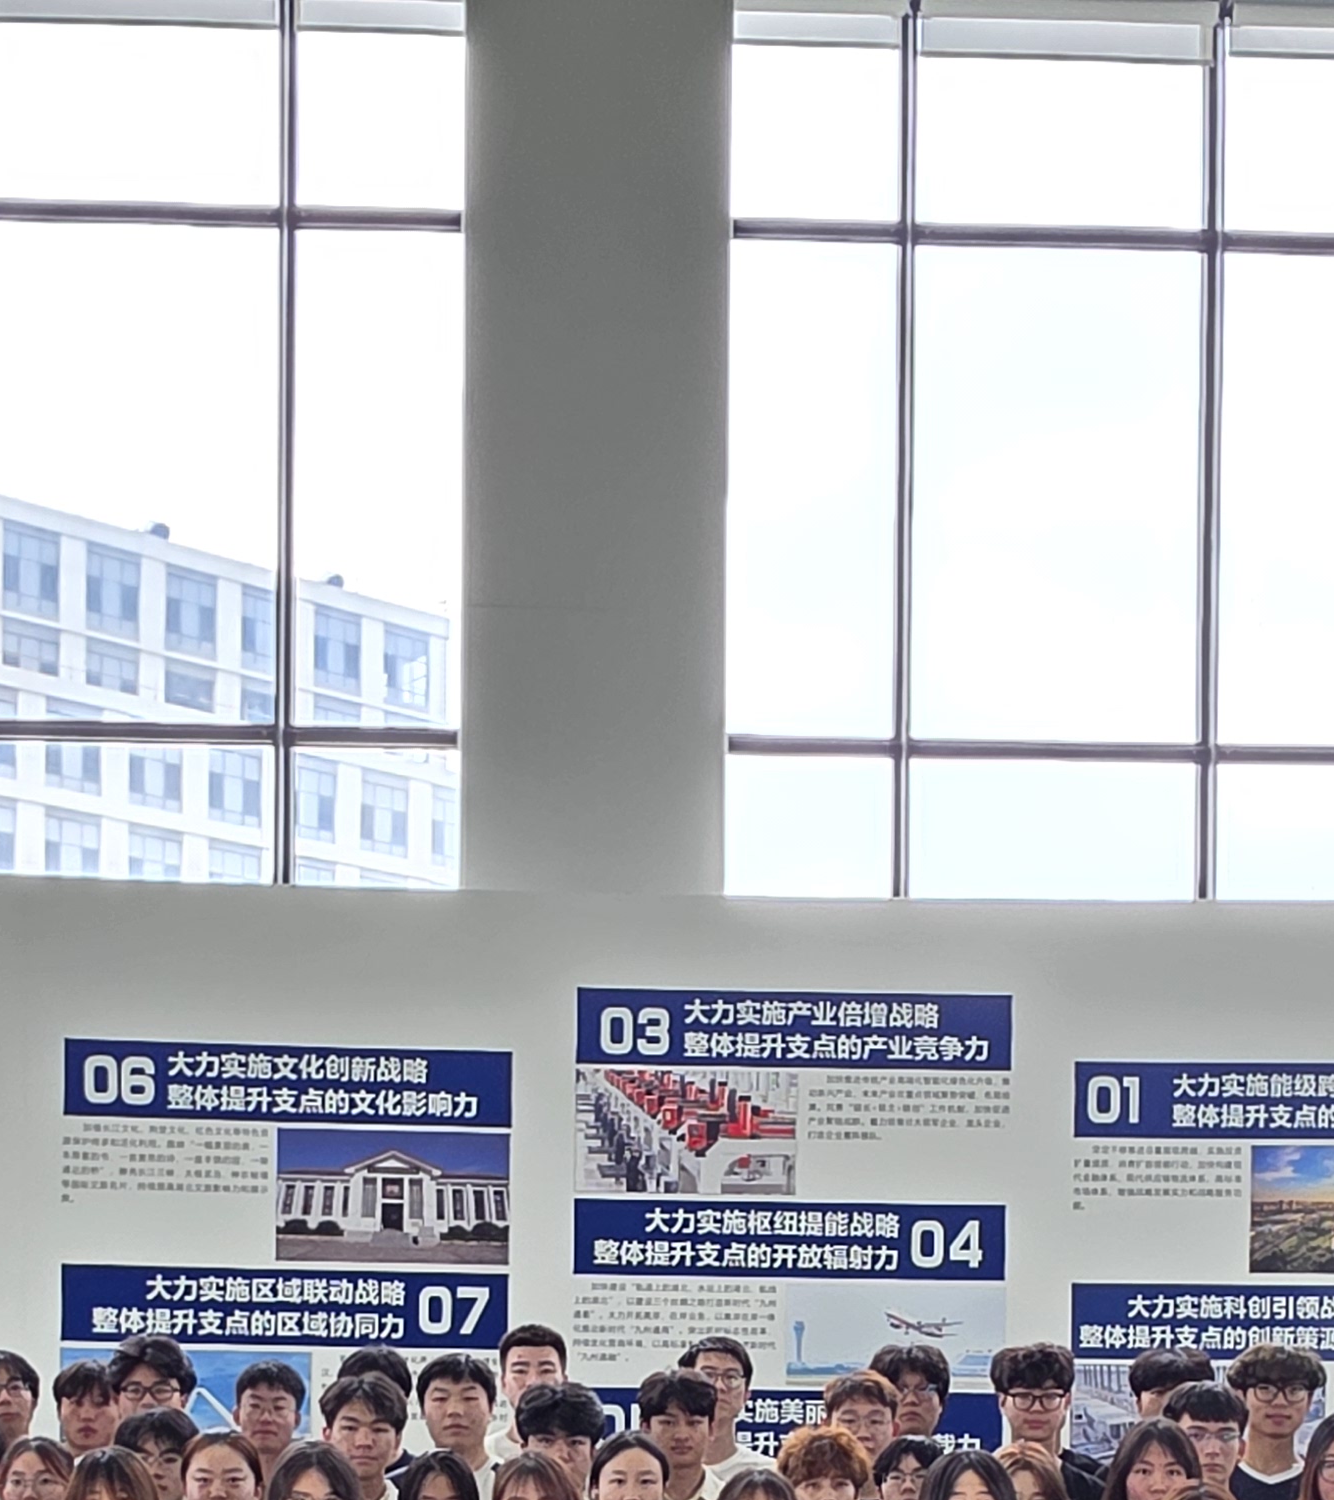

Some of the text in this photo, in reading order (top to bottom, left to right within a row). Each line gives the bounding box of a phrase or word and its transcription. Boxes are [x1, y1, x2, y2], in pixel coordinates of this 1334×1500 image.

[684, 998, 940, 1029] 大力实施产业倍增战略
[601, 1008, 669, 1055] 03
[683, 1031, 989, 1061] 整体提升支点的产业竞争力
[84, 1055, 154, 1105] 06
[167, 1050, 429, 1084] 大力实施文化创新战略
[166, 1084, 479, 1118] 整体提升支点的文化影响力
[1087, 1075, 1140, 1124] 01
[645, 1207, 900, 1239] 大力实施枢纽提能战略
[593, 1239, 899, 1271] 整体提升支点的开放辐射力
[910, 1220, 983, 1268] 04
[146, 1274, 406, 1306] 大力实施区域联动战略
[91, 1306, 405, 1339] 整体提升支点的区域协同力
[418, 1286, 490, 1335] 07
